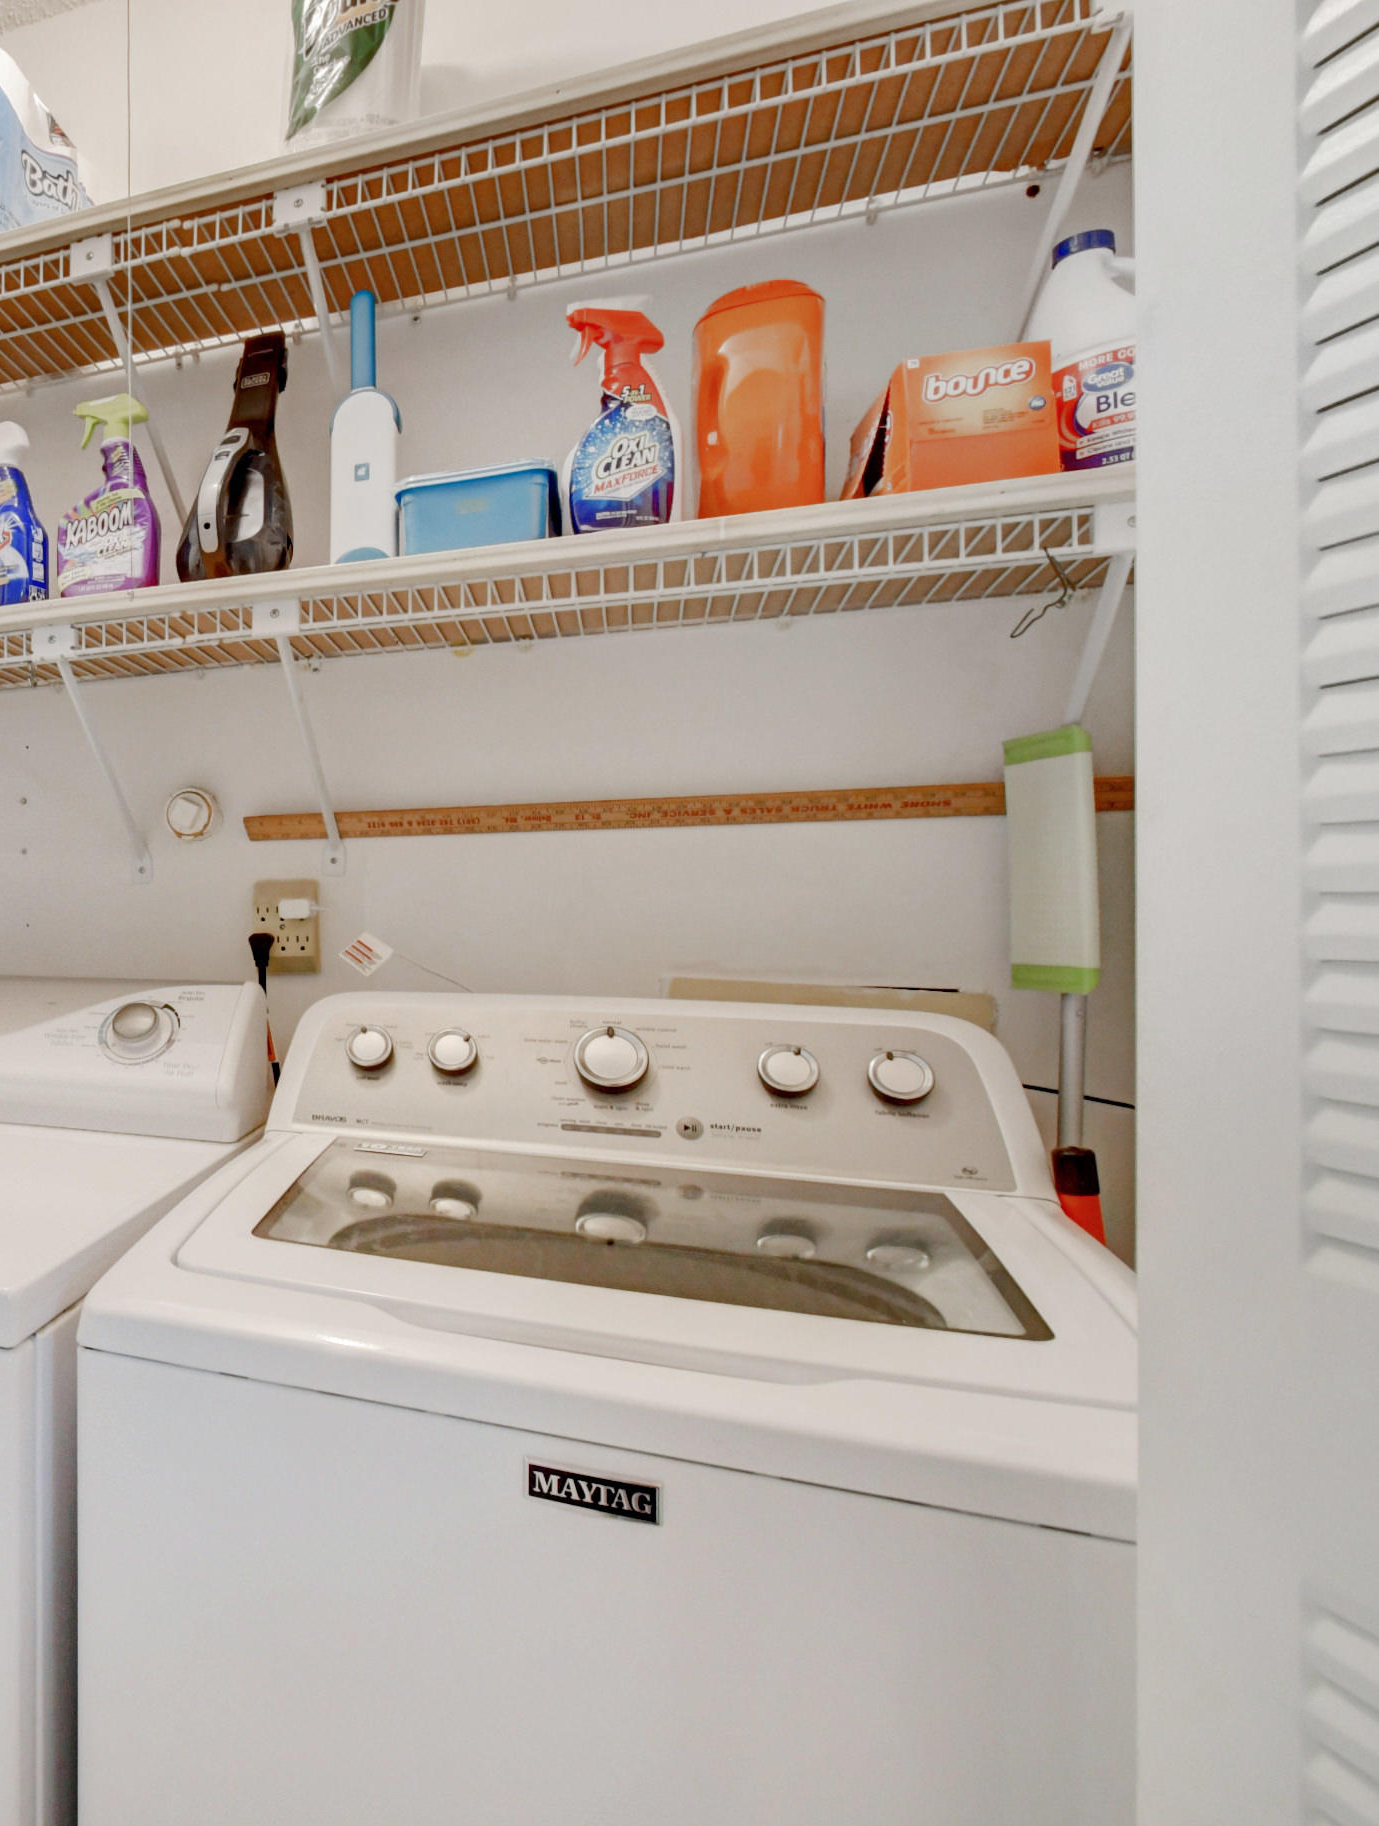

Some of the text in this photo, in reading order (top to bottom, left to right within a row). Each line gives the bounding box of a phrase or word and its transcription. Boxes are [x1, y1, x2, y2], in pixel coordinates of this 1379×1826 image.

[324, 8, 387, 46] ADVANCED
[1078, 352, 1114, 371] MORE
[924, 358, 1034, 402] bounce
[1088, 367, 1125, 386] Great
[612, 435, 646, 458] OXI
[596, 446, 656, 478] CLEAN
[65, 499, 133, 552] KABOOM
[739, 807, 783, 816] SALES
[790, 804, 838, 813] TRUCK
[845, 802, 893, 811] WHITE
[900, 799, 952, 809] SHORE
[709, 1123, 762, 1134] start/pause
[532, 1470, 653, 1515] MAYTAG
